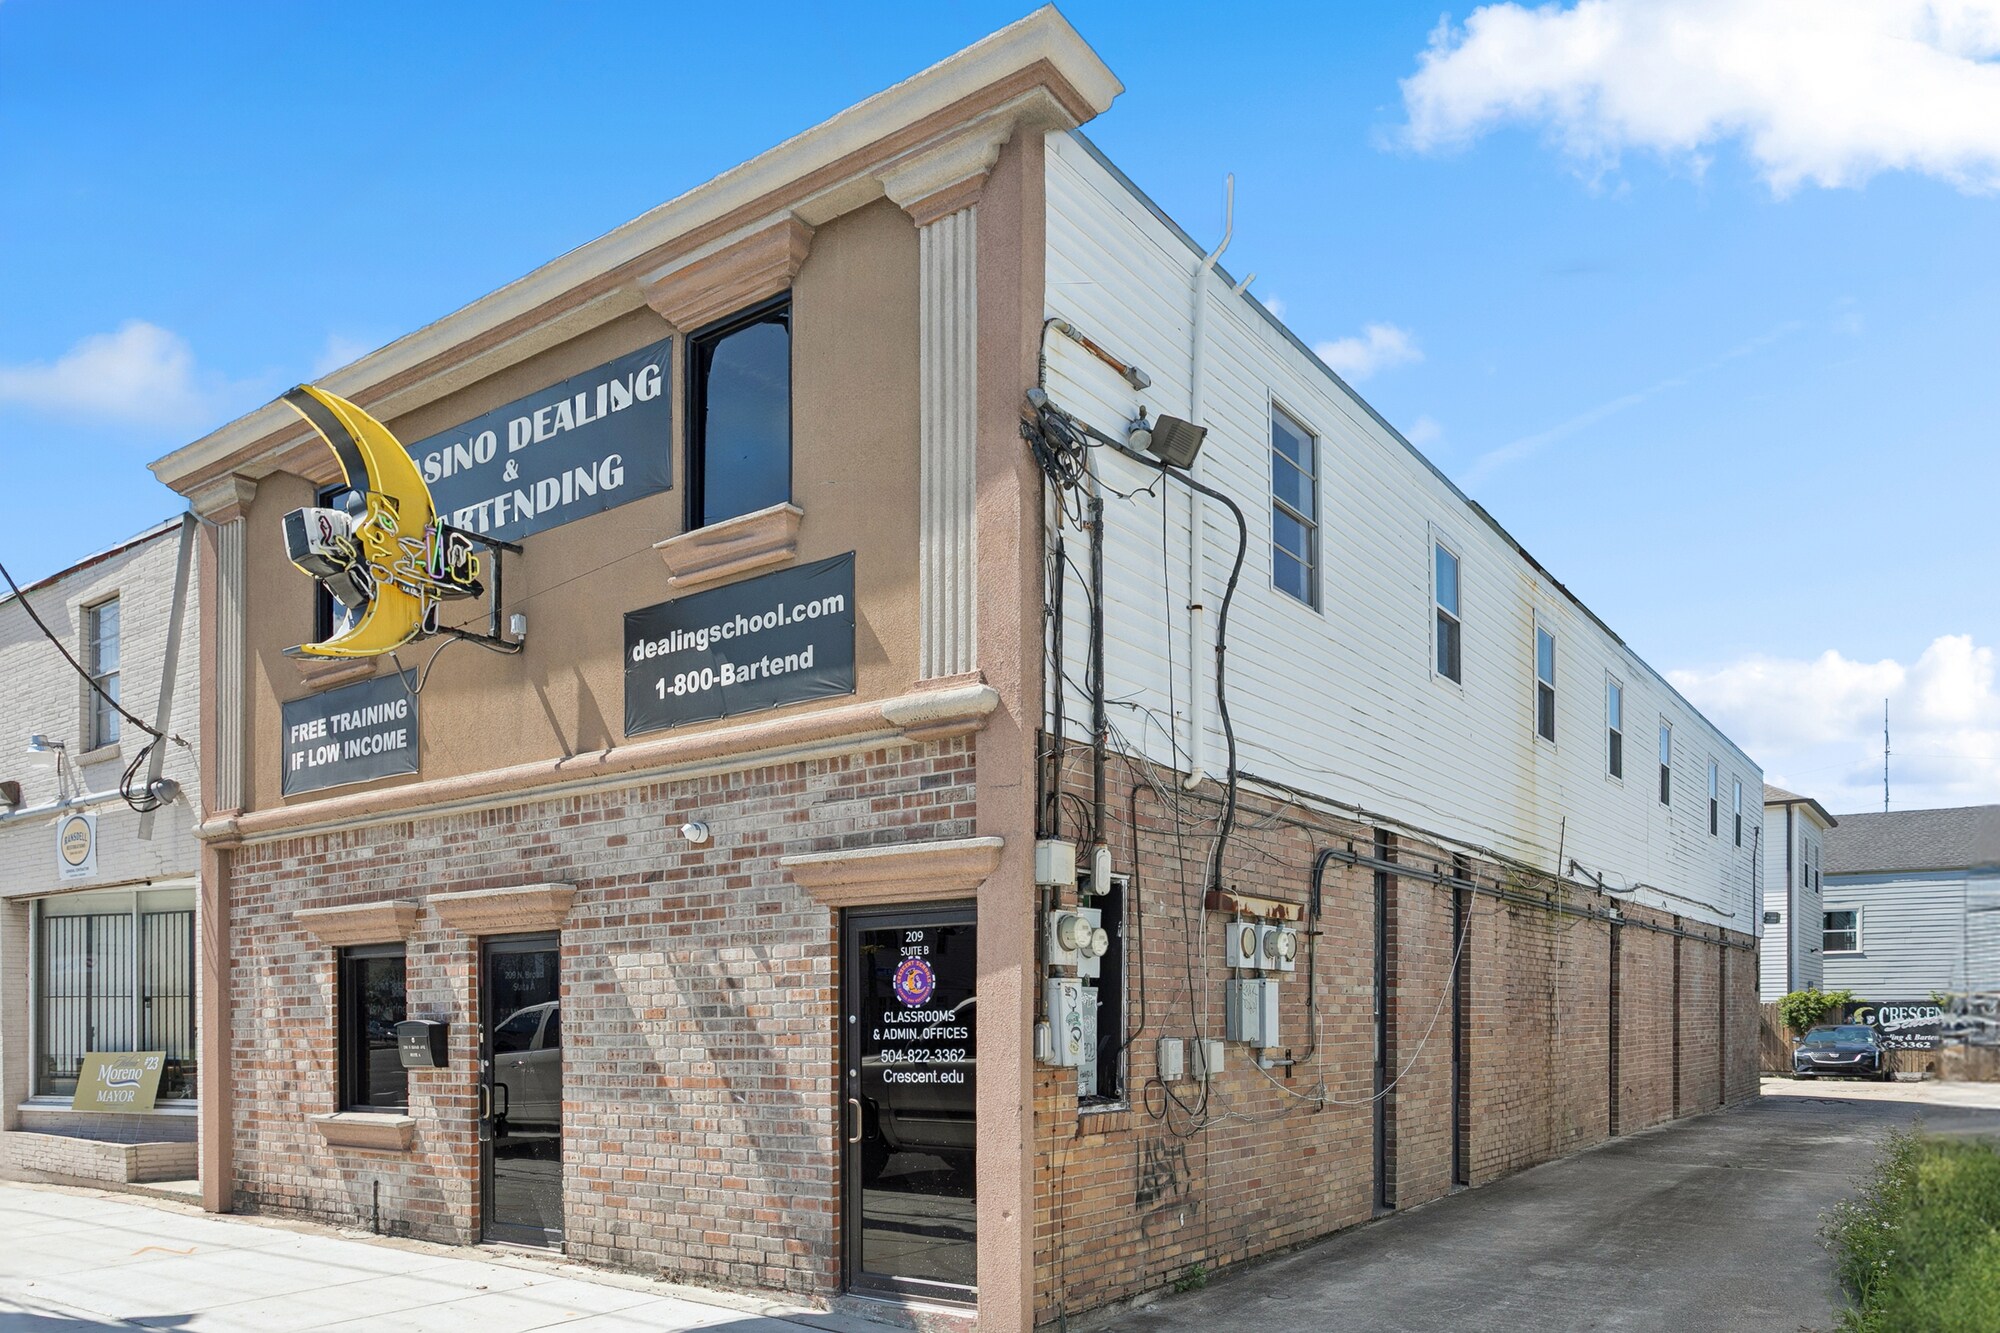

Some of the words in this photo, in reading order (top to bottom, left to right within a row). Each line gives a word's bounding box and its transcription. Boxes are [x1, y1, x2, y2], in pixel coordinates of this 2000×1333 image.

[411, 430, 497, 484] SINO
[508, 364, 661, 453] DEALING
[502, 459, 519, 483] &
[632, 594, 845, 662] dealingschool.com
[655, 645, 814, 700] 1-800-Bartend
[291, 718, 327, 744] FREE
[330, 699, 407, 734] TRAINING
[291, 751, 305, 771] IF
[308, 743, 340, 767] LOW
[344, 728, 407, 759] INCOME
[905, 930, 924, 942] 209
[900, 945, 923, 956] SUITE
[923, 945, 930, 955] B
[883, 1010, 956, 1023] CLASSROOMS
[1878, 1006, 1944, 1027] CRESCEN
[872, 1028, 881, 1040] &
[882, 1028, 920, 1040] ADMIN.
[922, 1026, 968, 1039] OFFICES
[880, 1048, 966, 1063] 504-822-3362
[96, 1064, 143, 1083] Moreno
[883, 1069, 964, 1084] Crescent.edu
[96, 1090, 135, 1103] MAYOR
